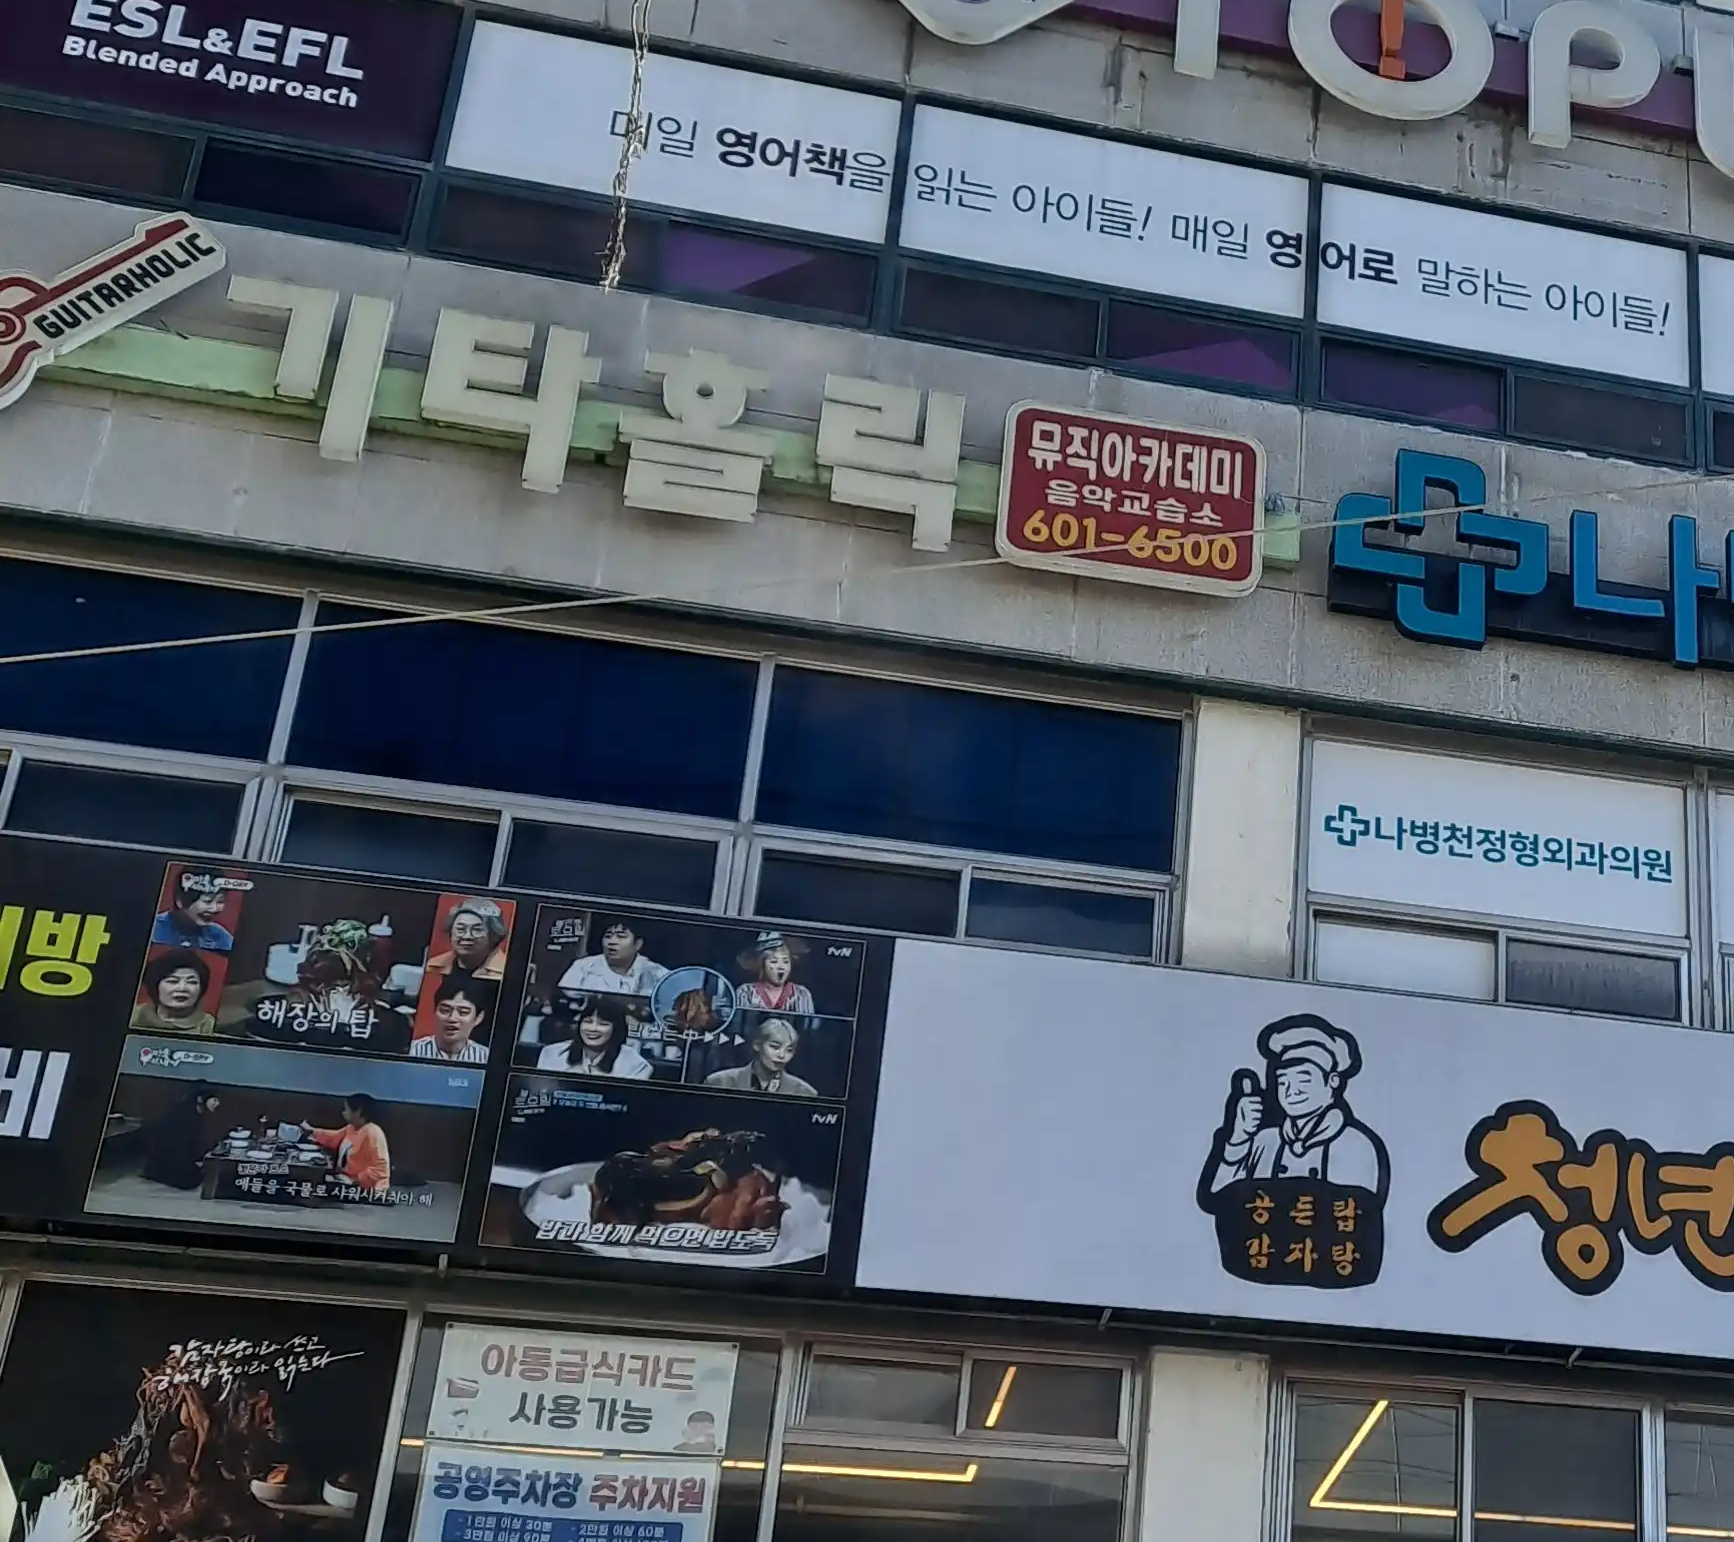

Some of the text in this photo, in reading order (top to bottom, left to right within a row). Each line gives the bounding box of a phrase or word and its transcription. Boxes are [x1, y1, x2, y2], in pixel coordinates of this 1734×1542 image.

[62, 35, 359, 108] Blended Approach
[715, 126, 890, 194] 영어책을
[914, 164, 997, 213] 읽는
[1011, 183, 1153, 241] 아이들!
[1171, 214, 1250, 260] 매일
[1417, 258, 1532, 311] 말하는
[1545, 283, 1670, 337] 아이들!
[32, 232, 217, 339] GUITARHOLIC
[226, 274, 966, 552] 기타홀릭
[1027, 419, 1243, 500] 뮤직아카데미
[1045, 478, 1223, 527] 음악교습소
[1022, 509, 1238, 571] 601-6500
[1374, 816, 1673, 884] 나병천정형외과의원
[0, 905, 111, 997] 방
[827, 946, 853, 957] tvN
[257, 999, 380, 1039] 해장의 탑
[811, 1112, 838, 1124] tvN
[480, 1343, 697, 1391] 아동급식카드
[433, 1462, 707, 1514] 공영주차장 주차지원
